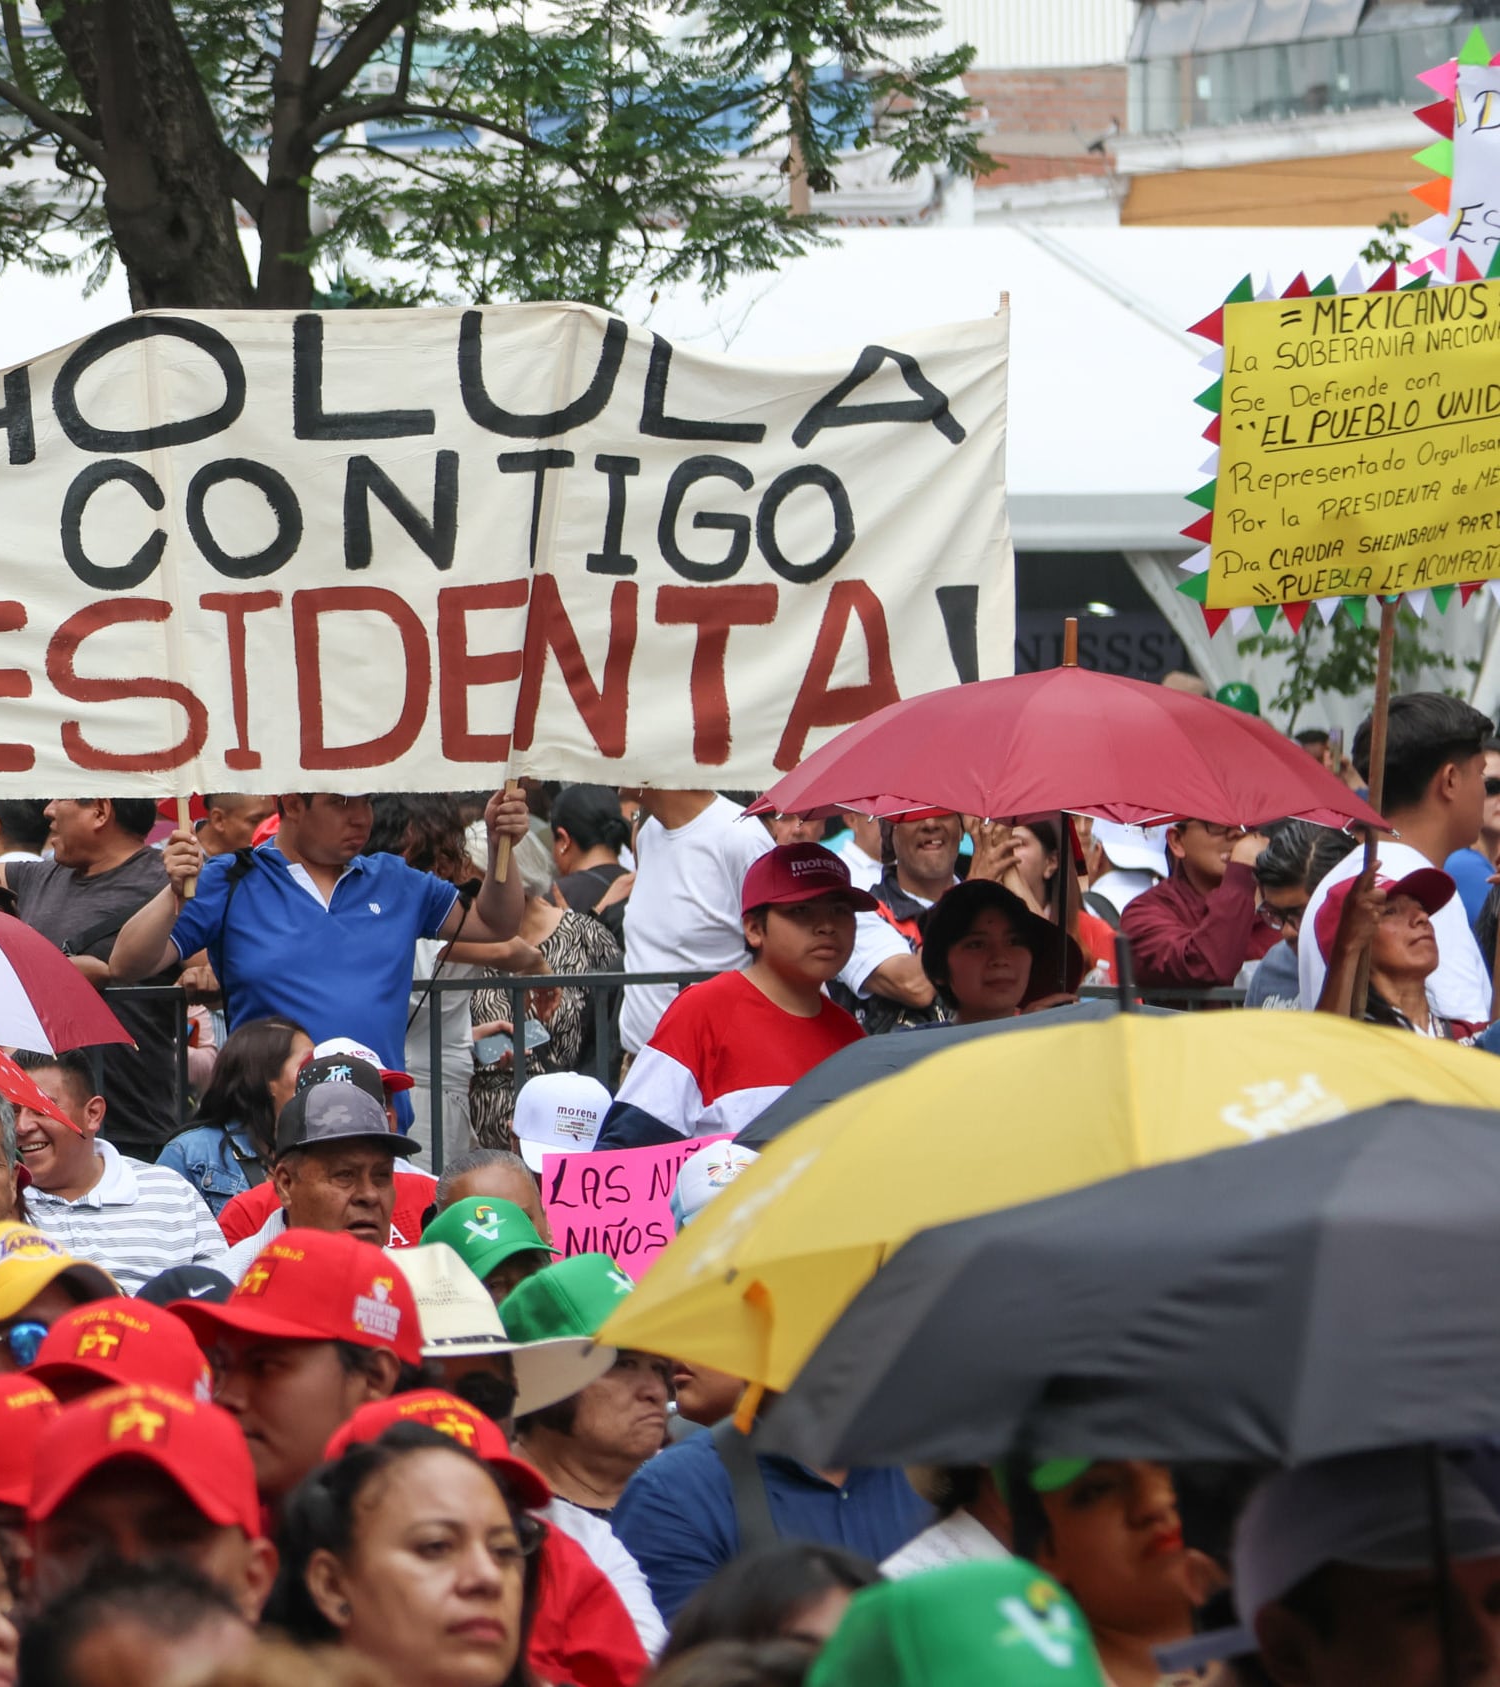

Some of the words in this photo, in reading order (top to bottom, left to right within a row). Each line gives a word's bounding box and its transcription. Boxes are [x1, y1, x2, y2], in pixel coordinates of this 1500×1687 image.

[1312, 282, 1489, 336] MEXICANOS
[1229, 345, 1258, 374] La
[1272, 331, 1415, 371] SOBERANIA
[1426, 319, 1500, 353] NACION
[1230, 385, 1266, 416] Se
[1290, 375, 1389, 408] Defiende
[1405, 371, 1441, 391] con
[1307, 399, 1420, 443] PUEBLO
[1228, 447, 1406, 500] Representado
[1417, 434, 1500, 466] Orgullosa
[61, 450, 855, 590] CONTIGO
[1227, 508, 1267, 534] Por
[1281, 507, 1300, 527] la
[1317, 480, 1442, 521] PRESIDENTA
[1451, 477, 1468, 496] de
[1268, 539, 1345, 570] CLAUDIA
[1357, 521, 1450, 554] SHEINBAUM
[1456, 510, 1500, 535] PAR
[1380, 562, 1409, 591] LE
[1412, 544, 1500, 585] ACOMPAÑ
[556, 1105, 597, 1120] morena
[549, 1157, 632, 1210] LAS
[565, 1217, 668, 1260] NIÑOS
[77, 1325, 119, 1357] PT
